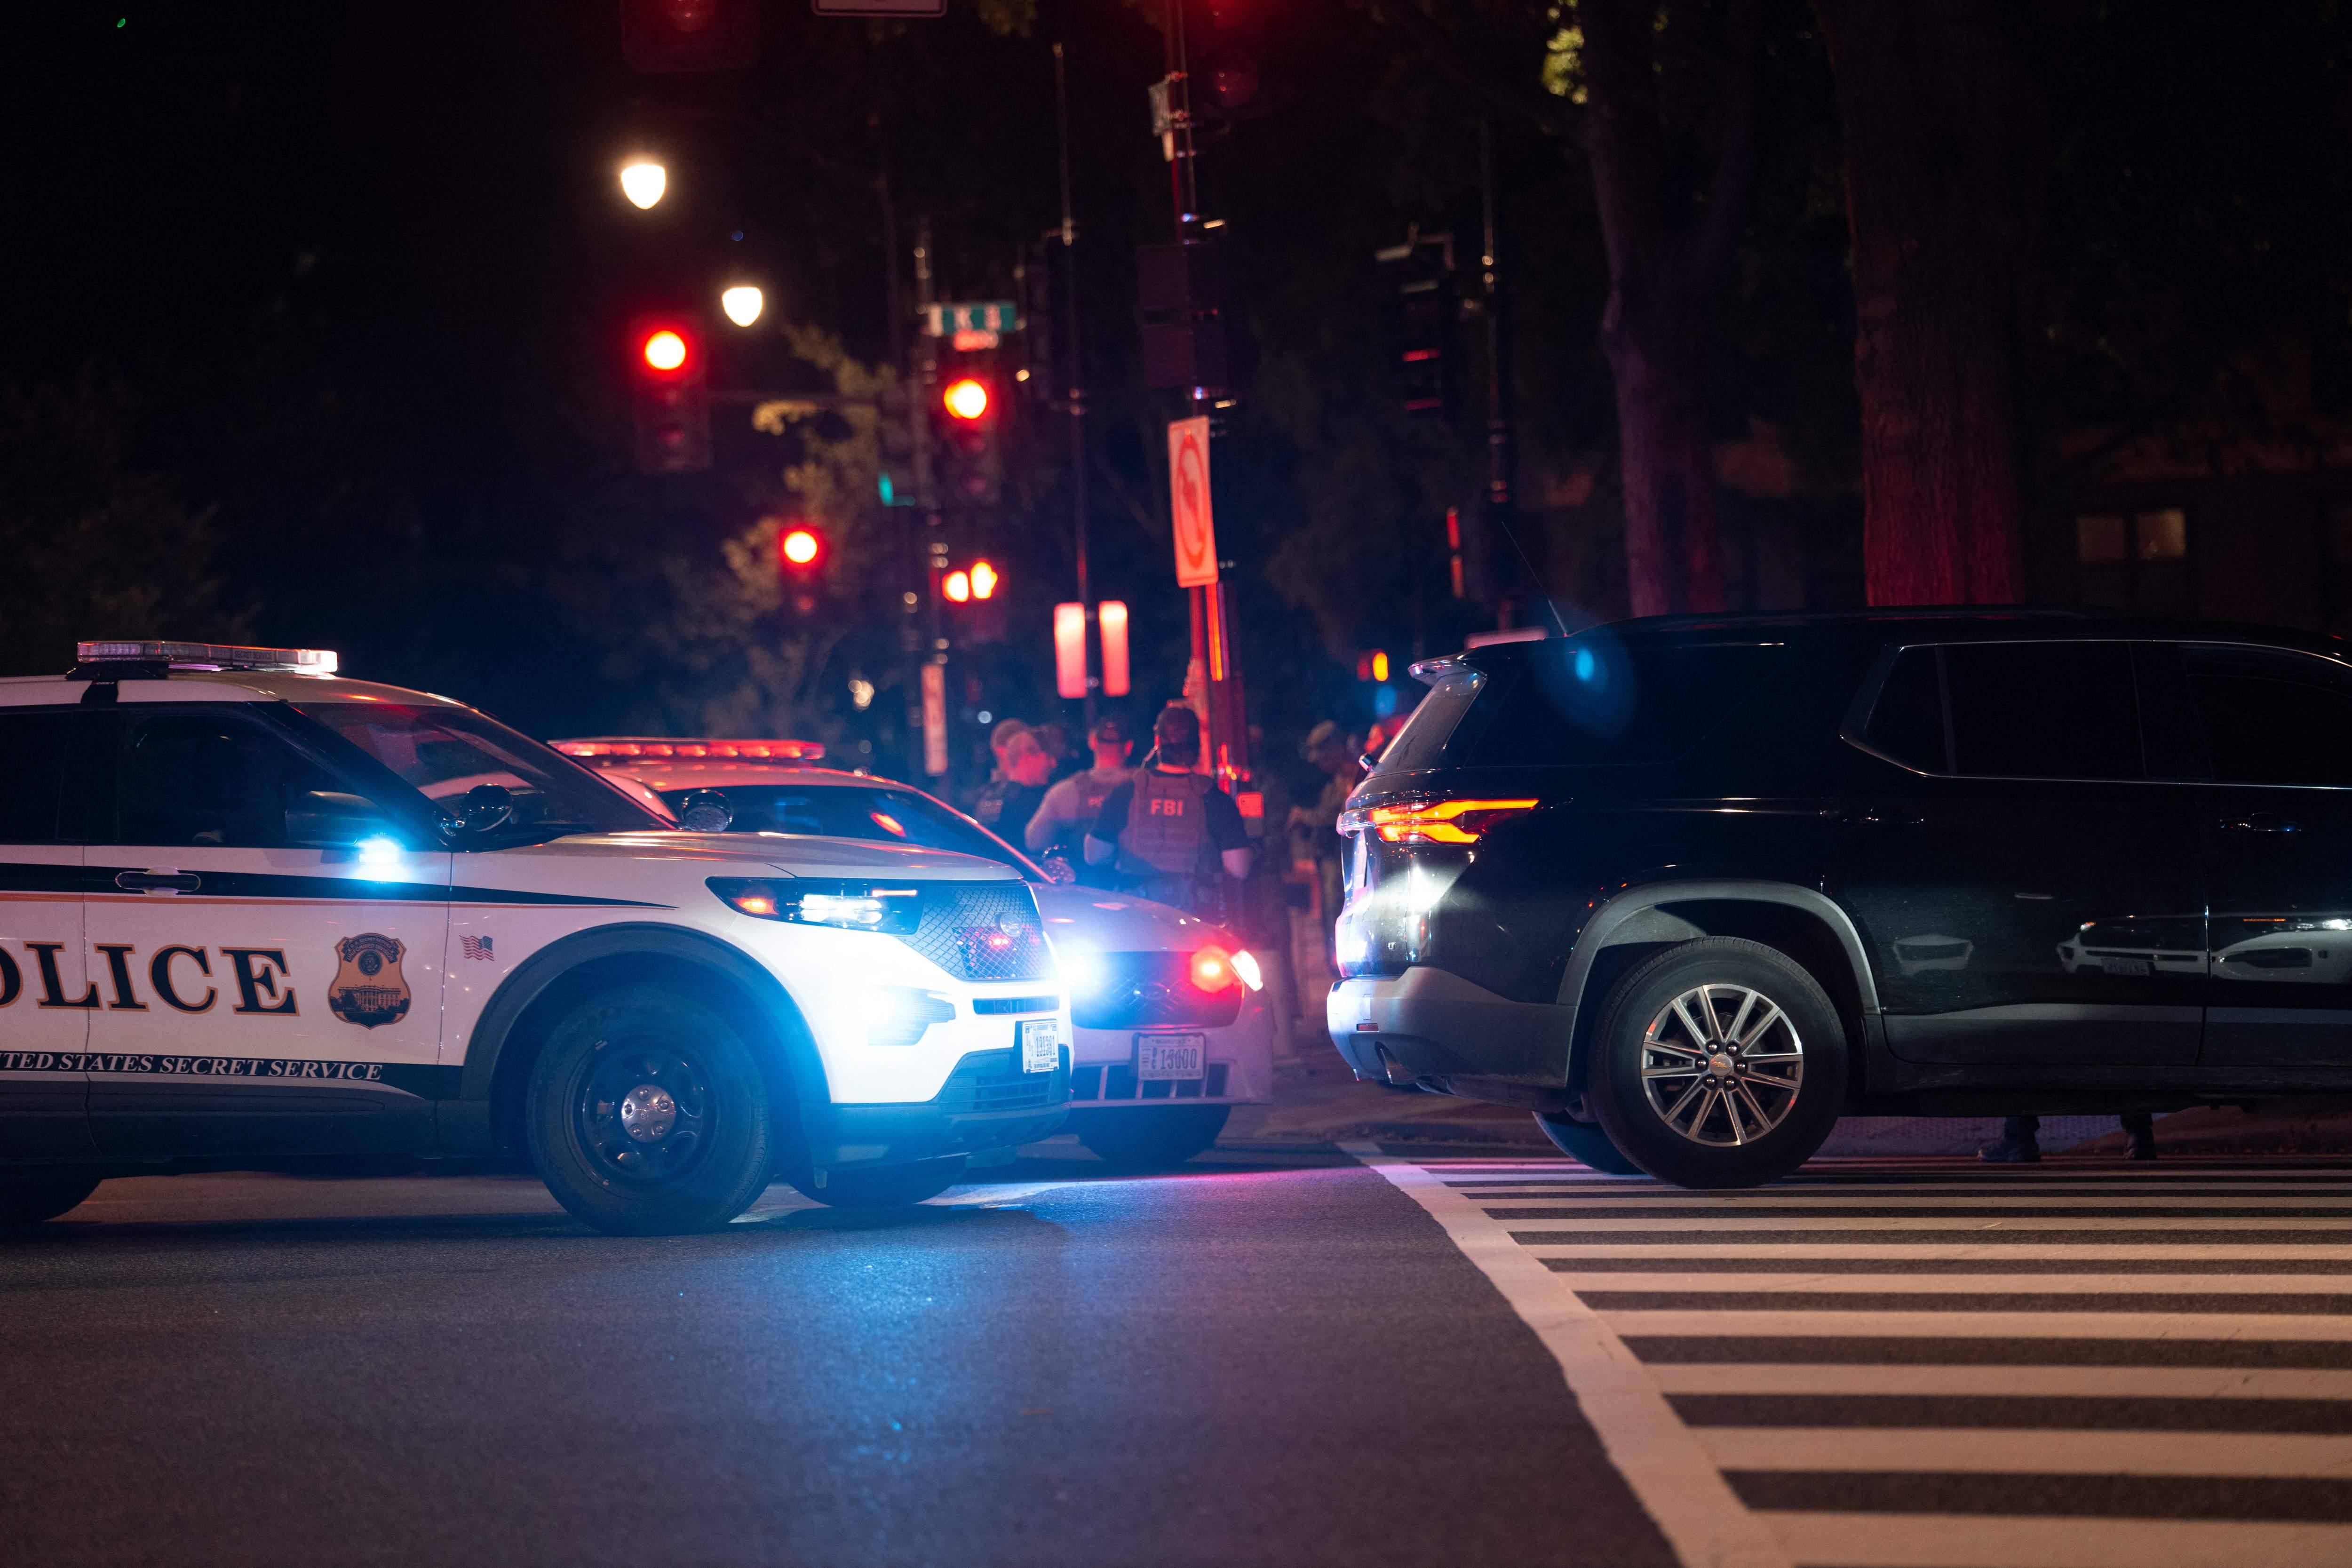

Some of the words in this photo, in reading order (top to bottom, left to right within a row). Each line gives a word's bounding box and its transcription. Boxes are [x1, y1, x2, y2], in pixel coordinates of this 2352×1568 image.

[1151, 798, 1184, 816] FBI
[0, 1052, 53, 1069] TED
[58, 1054, 154, 1072] STATES
[159, 1057, 264, 1076] SECRET
[268, 1060, 383, 1080] SERVICE
